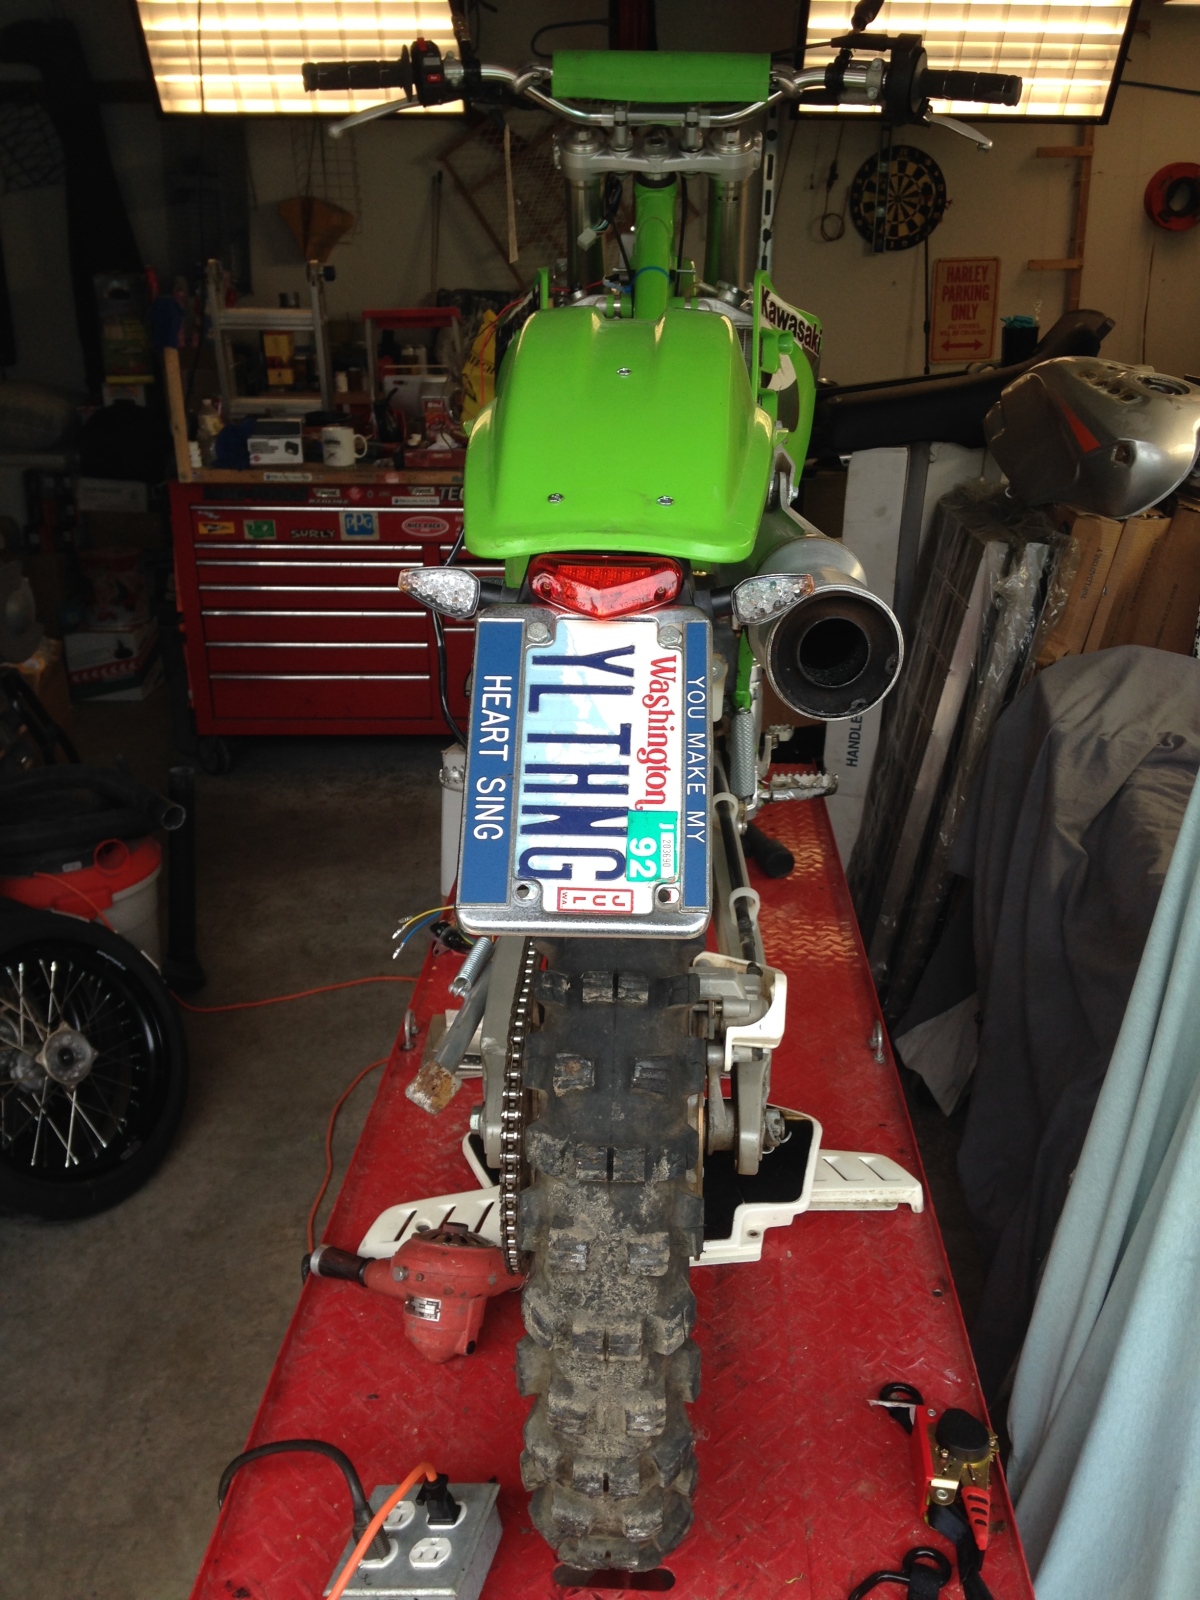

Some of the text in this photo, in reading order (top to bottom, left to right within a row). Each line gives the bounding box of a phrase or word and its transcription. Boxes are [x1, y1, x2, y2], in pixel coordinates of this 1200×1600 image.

[946, 265, 989, 283] HARLEY
[941, 284, 990, 302] PARKING
[761, 285, 823, 355] Kawasaki
[951, 303, 979, 321] ONLY
[290, 529, 336, 539] SURLY
[345, 513, 373, 532] PPG
[634, 655, 677, 811] Washington
[473, 675, 513, 840] HEART SING
[517, 645, 636, 881] YLTHNG
[686, 675, 706, 843] YOU MAKE MY
[629, 837, 658, 878] 92
[662, 839, 672, 868] 203690
